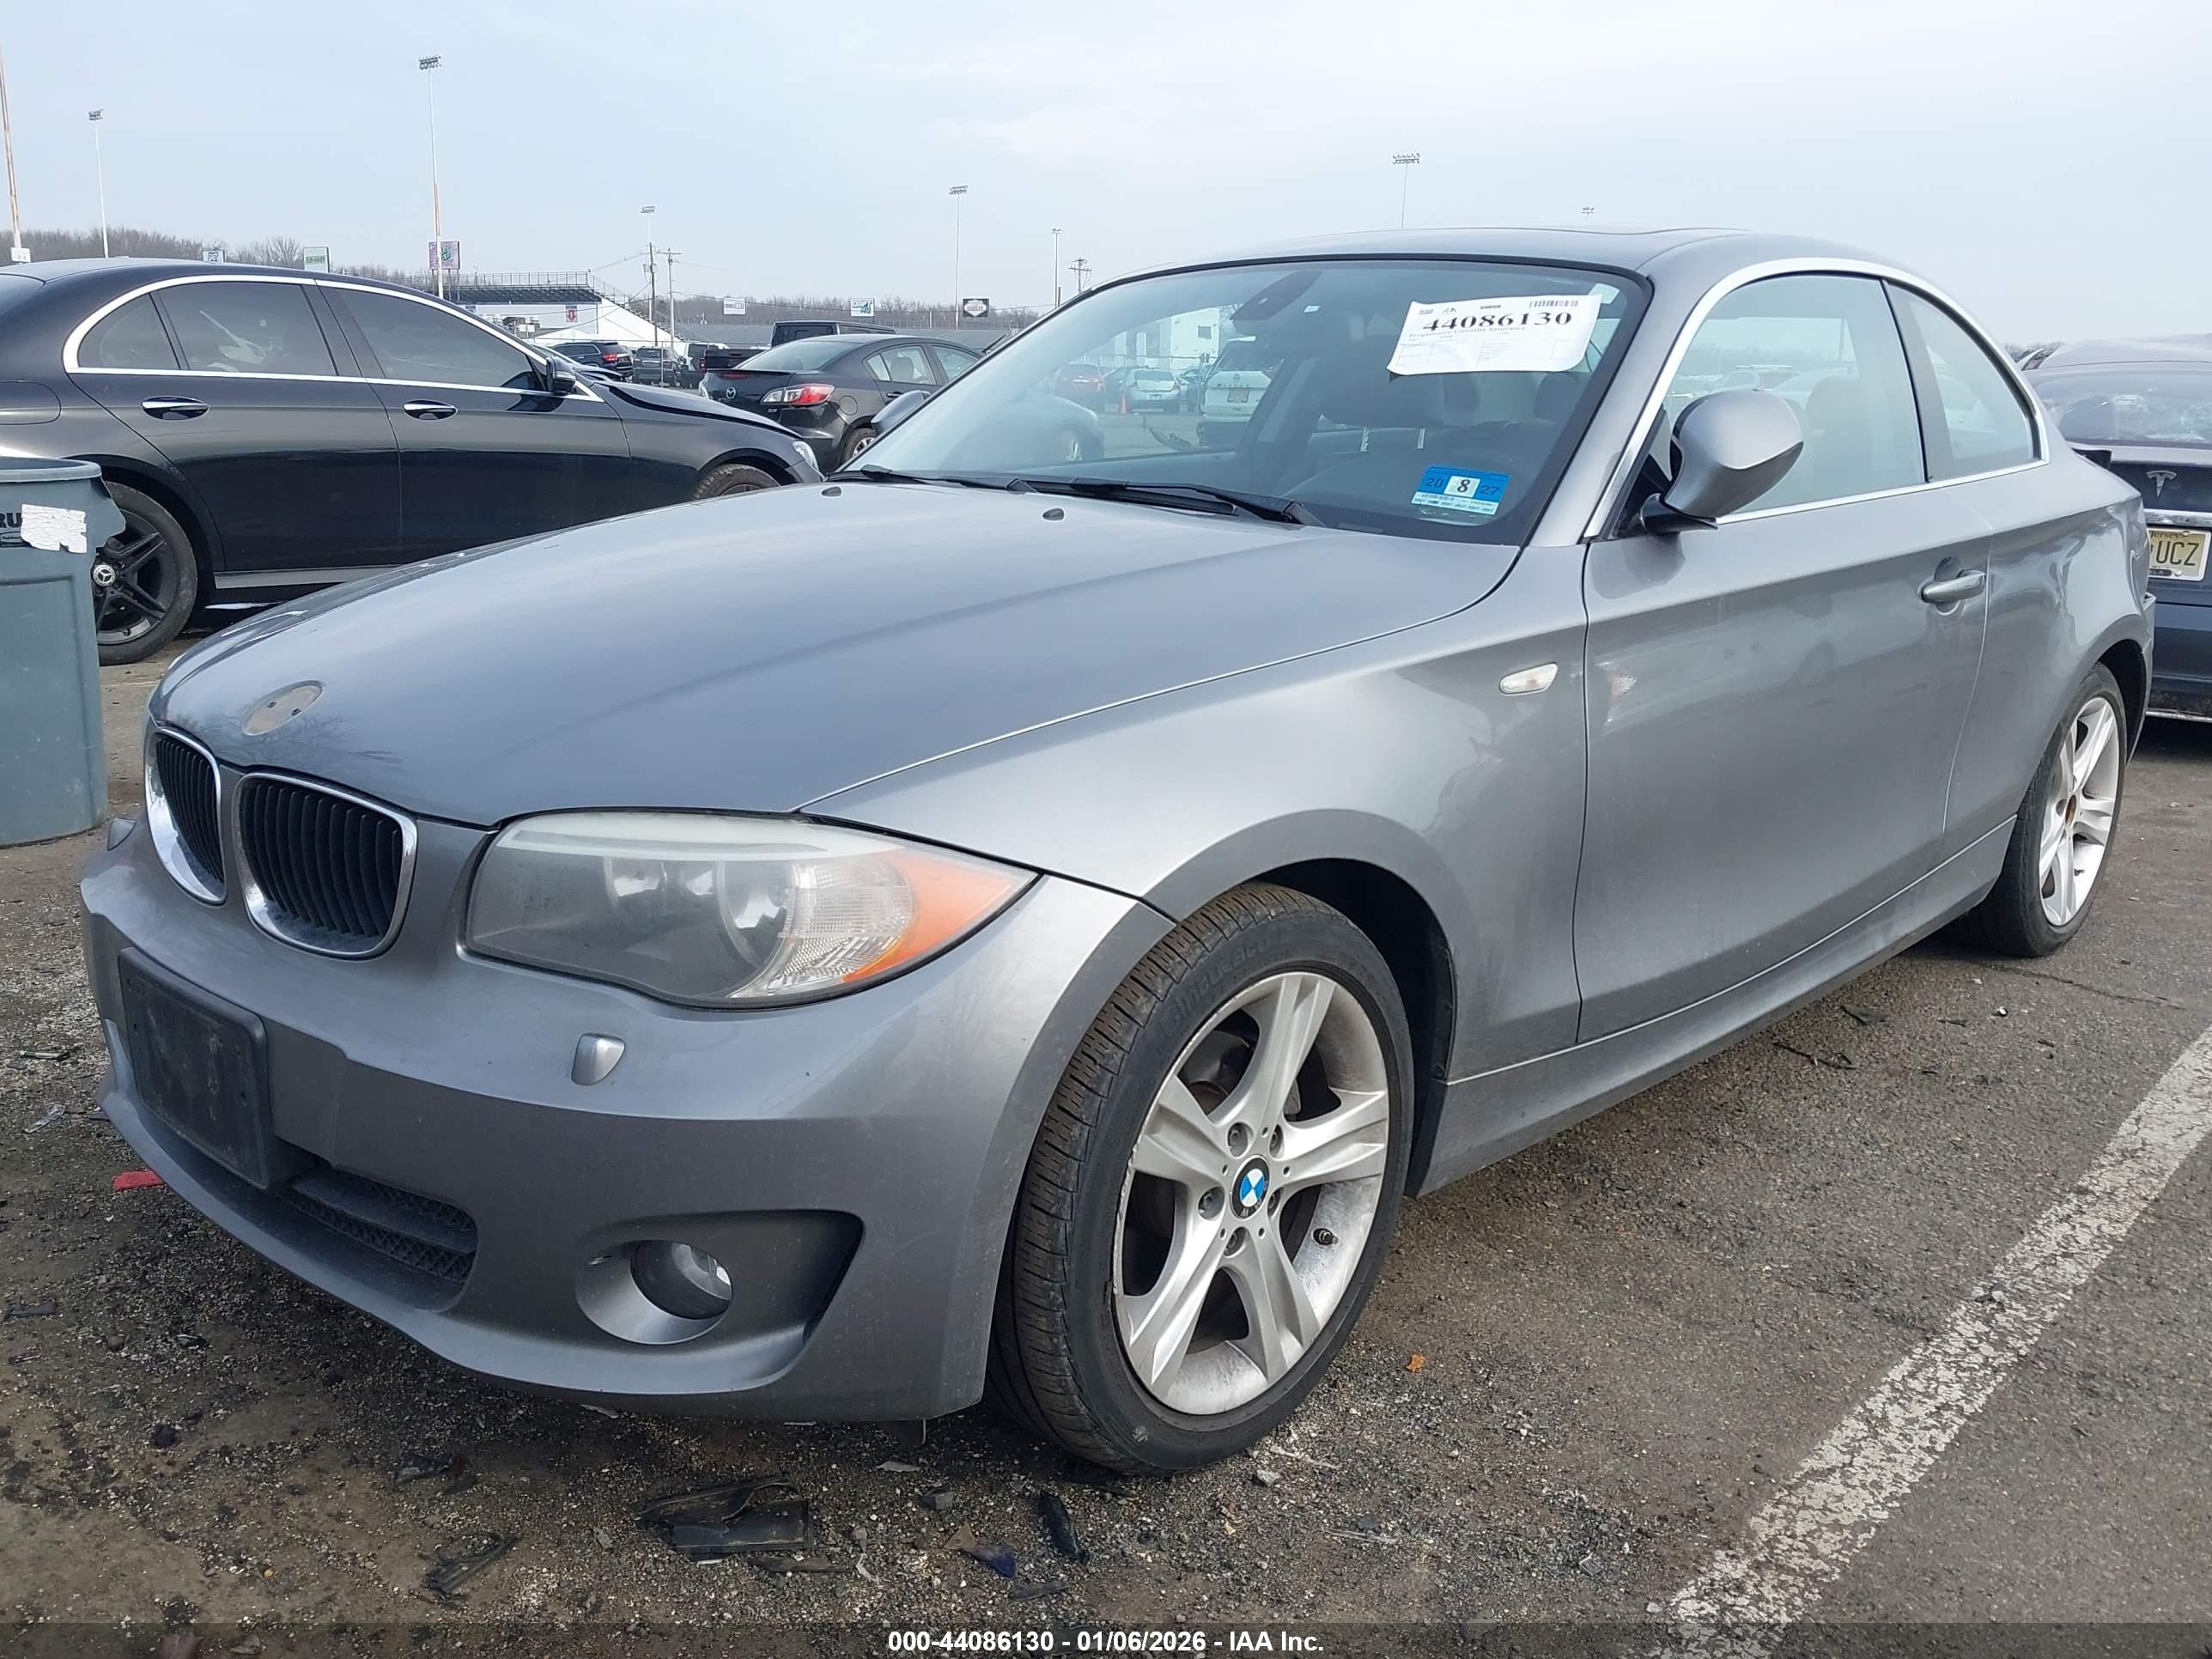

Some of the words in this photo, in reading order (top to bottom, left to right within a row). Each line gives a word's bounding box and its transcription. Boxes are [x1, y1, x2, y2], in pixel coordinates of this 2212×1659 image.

[1422, 312, 1572, 331] 44086130
[1425, 477, 1443, 489] 20
[1457, 479, 1470, 493] 8
[1480, 485, 1500, 495] 27
[2156, 541, 2199, 566] UCZ
